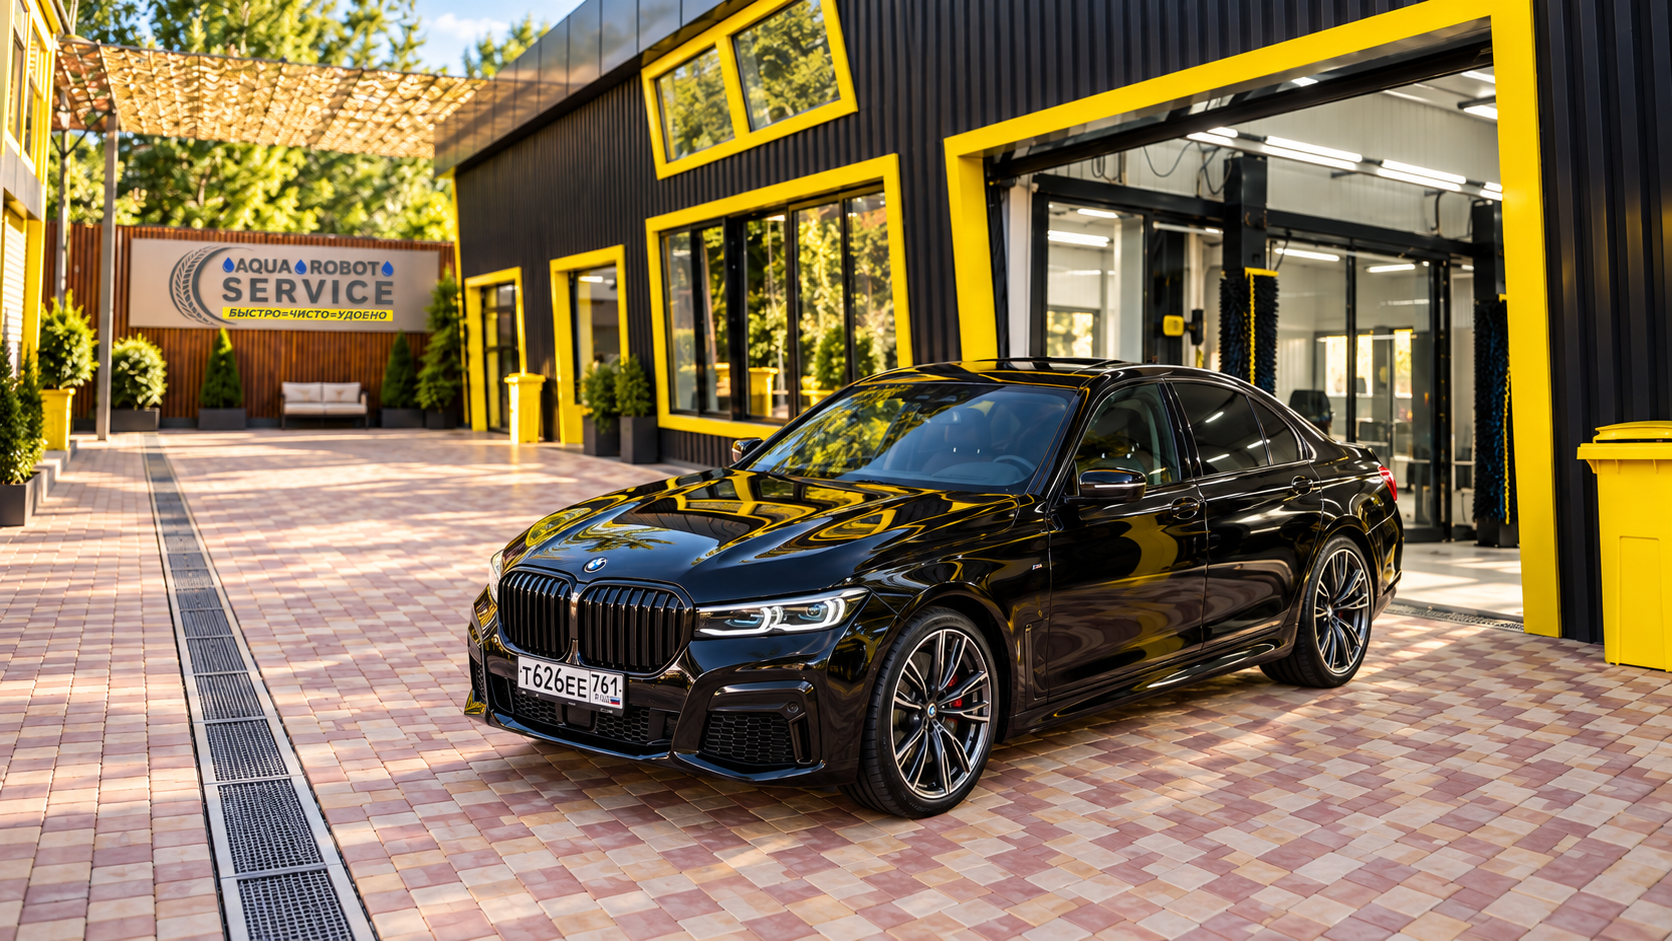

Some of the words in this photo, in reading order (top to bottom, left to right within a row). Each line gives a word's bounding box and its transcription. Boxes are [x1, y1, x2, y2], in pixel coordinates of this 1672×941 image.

[235, 257, 292, 274] AQUA
[310, 259, 380, 276] ROBOT
[222, 277, 394, 305] SERVICE
[591, 673, 618, 696] 761
